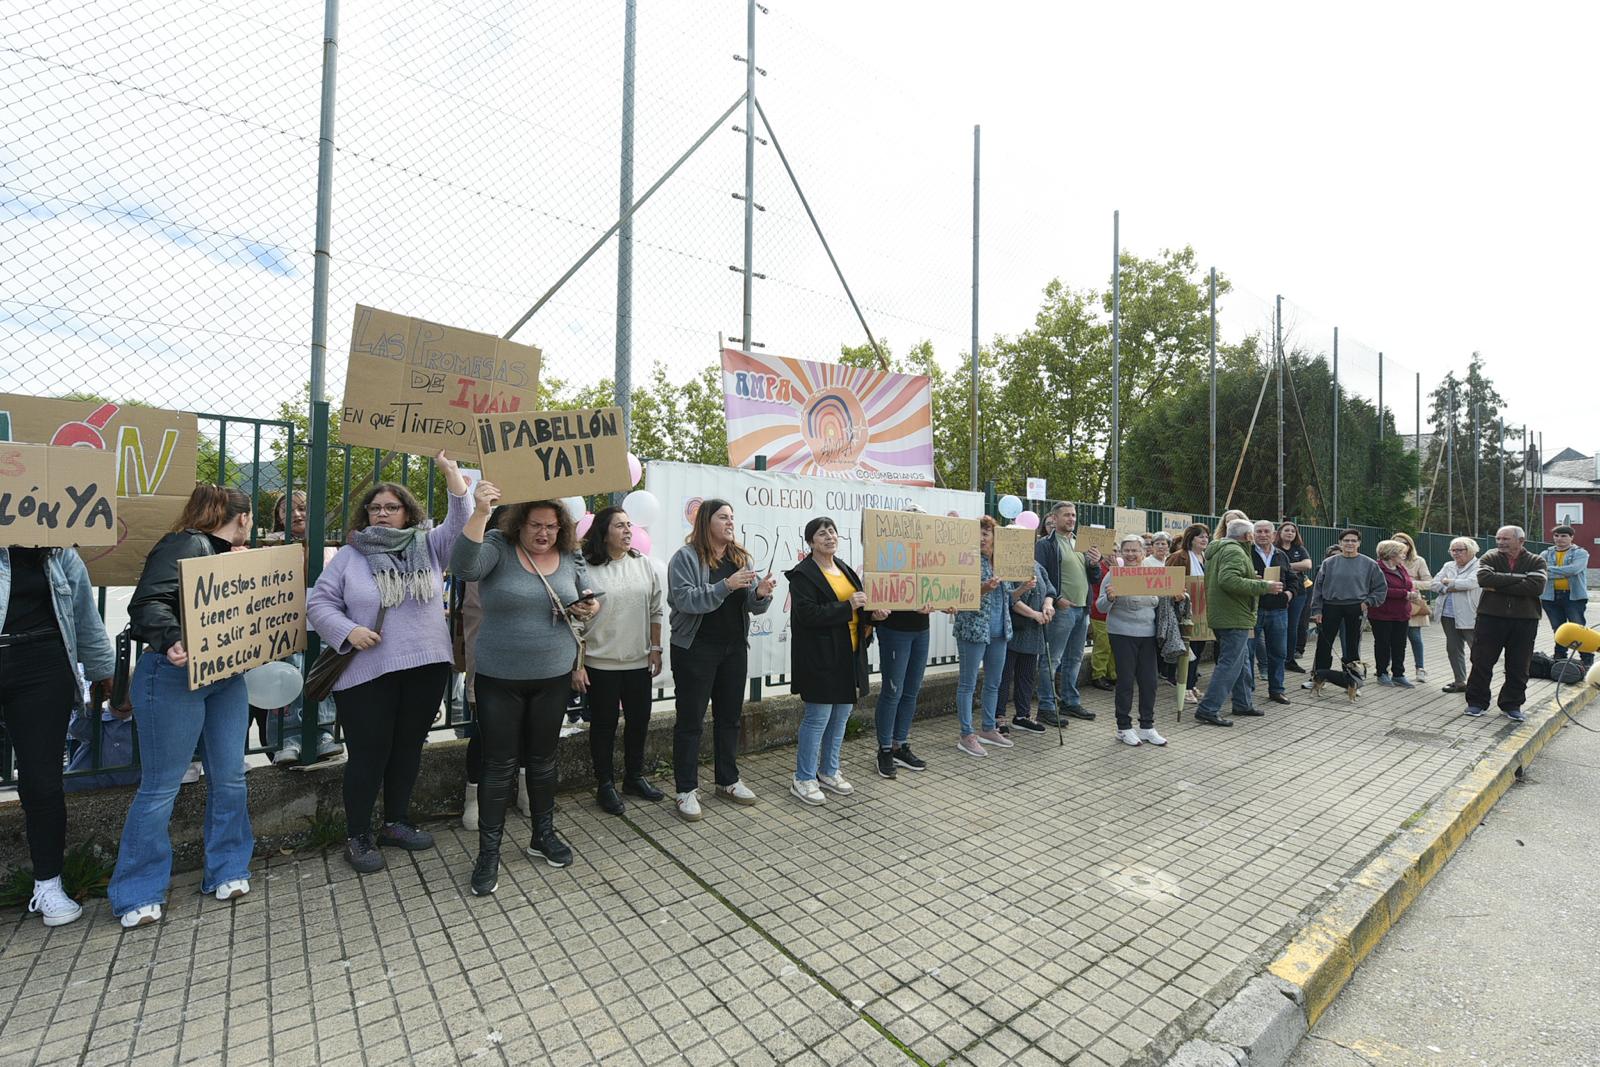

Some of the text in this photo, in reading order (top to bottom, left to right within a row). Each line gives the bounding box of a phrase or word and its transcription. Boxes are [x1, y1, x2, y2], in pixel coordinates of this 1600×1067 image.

[411, 322, 528, 387] PROMESAS
[411, 370, 521, 413] DE IVÁN
[735, 371, 793, 404] AMPA
[343, 407, 364, 424] EN
[369, 409, 398, 430] QUÉ
[535, 443, 596, 481] YA!!
[856, 469, 925, 481] COLUMBRIANOS
[65, 483, 113, 529] YA
[745, 486, 813, 510] COLEGIO
[876, 541, 907, 571] NO
[261, 569, 293, 588] niños
[200, 590, 294, 628] tienen derecho
[200, 611, 299, 652] a salir al recreo
[268, 628, 298, 660] YA!
